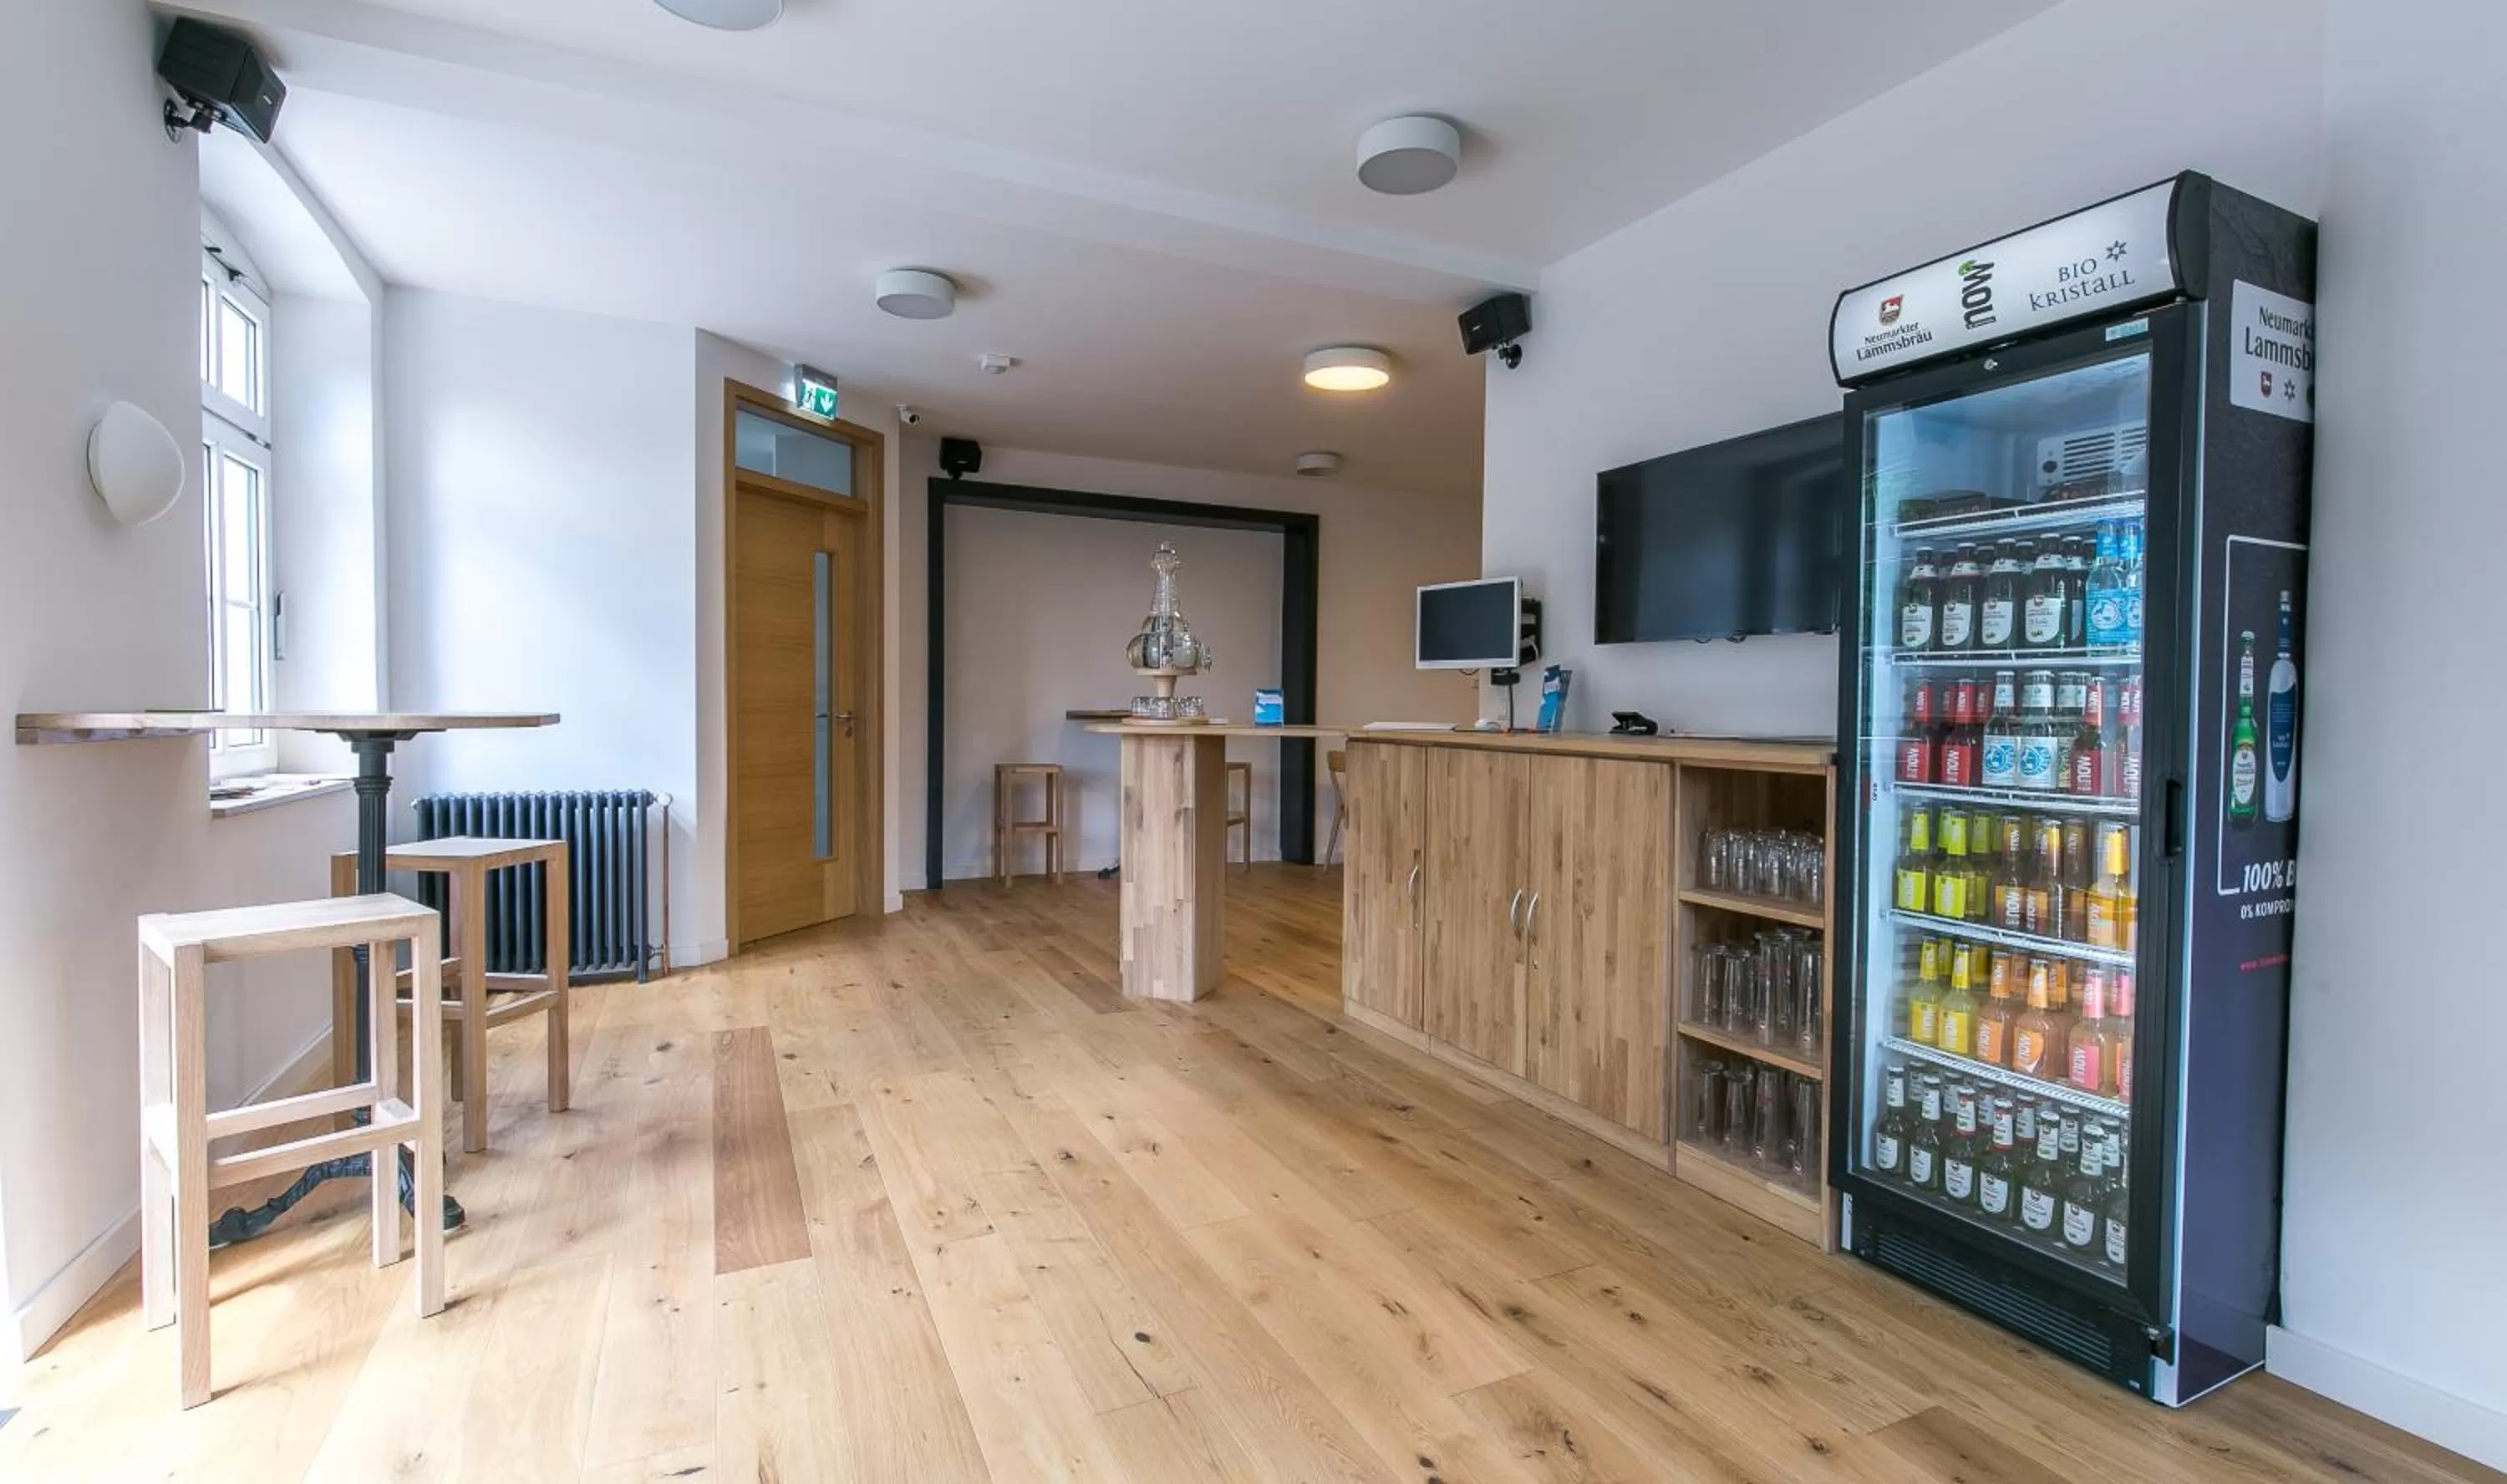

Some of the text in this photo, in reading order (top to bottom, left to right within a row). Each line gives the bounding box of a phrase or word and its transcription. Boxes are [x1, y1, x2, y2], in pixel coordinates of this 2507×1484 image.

[2057, 257, 2098, 282] BIO
[1959, 260, 1996, 330] now
[1855, 331, 1934, 361] Lammsbräu
[1864, 322, 1920, 345] Neumarkter
[2245, 326, 2312, 371] Lammsb
[2242, 860, 2284, 892] 100%
[2240, 903, 2253, 920] 0%
